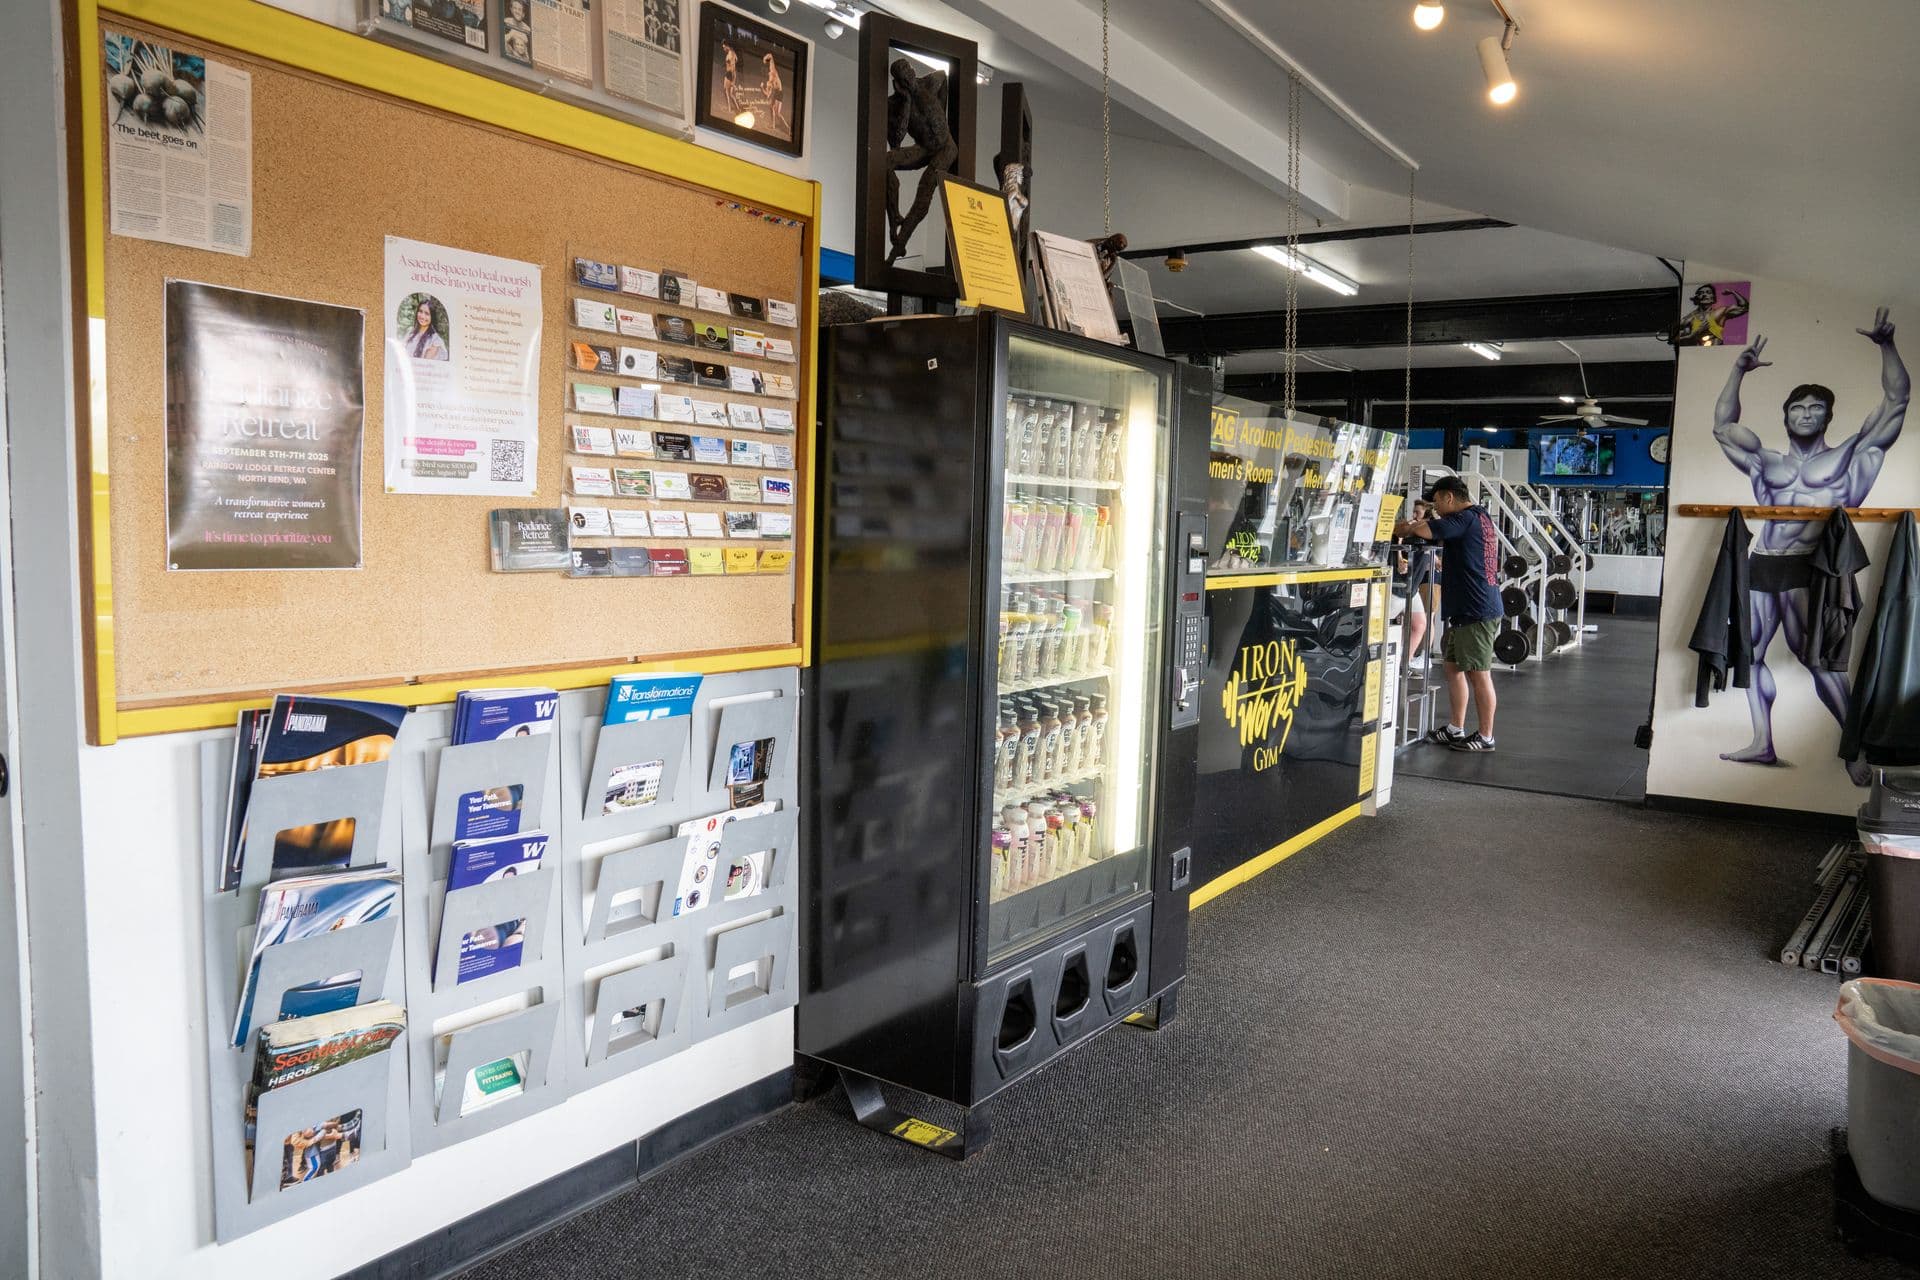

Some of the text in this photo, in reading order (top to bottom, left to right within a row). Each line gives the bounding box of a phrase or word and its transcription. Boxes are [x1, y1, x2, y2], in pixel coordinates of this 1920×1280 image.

[117, 123, 136, 135] The
[138, 128, 160, 140] beet
[162, 134, 184, 146] goes
[186, 140, 198, 149] on
[399, 255, 408, 266] A
[408, 258, 440, 273] sacred
[440, 264, 468, 280] space
[468, 267, 480, 278] to
[501, 274, 532, 290] nourish
[411, 271, 524, 299] and rise into your best self
[1239, 418, 1284, 450] Around
[268, 449, 305, 460] 5TH-7TH
[307, 451, 329, 461] 2025
[244, 462, 273, 472] LODGE
[273, 464, 305, 474] RETREAT
[307, 465, 337, 475] CENTER
[1245, 459, 1274, 484] Room
[238, 473, 266, 483] NORTH
[293, 476, 307, 485] WA
[766, 479, 791, 493] CARS
[214, 495, 326, 509] A transformative women's
[234, 510, 309, 522] retreat experience
[518, 521, 552, 531] Radiance
[204, 530, 332, 546] It's time to prioritize you
[523, 530, 550, 540] Retreat
[1240, 637, 1296, 684] IRON
[535, 700, 559, 718] W
[289, 713, 328, 732] PANORAMA
[523, 842, 547, 859] W
[279, 902, 320, 919] PANORAMA
[268, 1063, 321, 1088] HEROES
